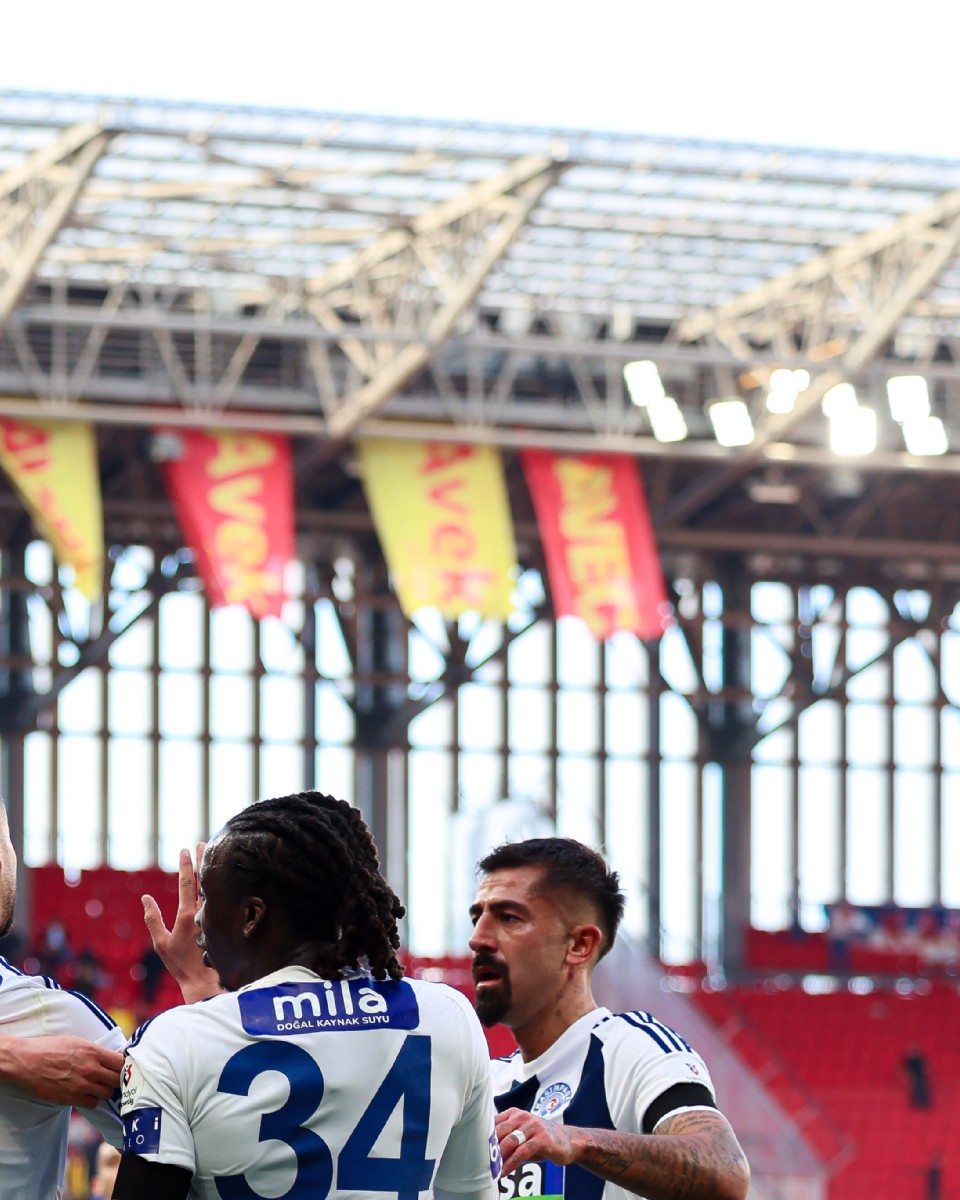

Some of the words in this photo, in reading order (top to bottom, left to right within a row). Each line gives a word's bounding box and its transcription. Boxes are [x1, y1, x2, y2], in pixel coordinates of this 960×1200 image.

[272, 980, 388, 1021] mila
[276, 1020, 314, 1032] DOĞAL
[316, 1017, 359, 1027] KAYNAK
[362, 1015, 390, 1024] SUYU
